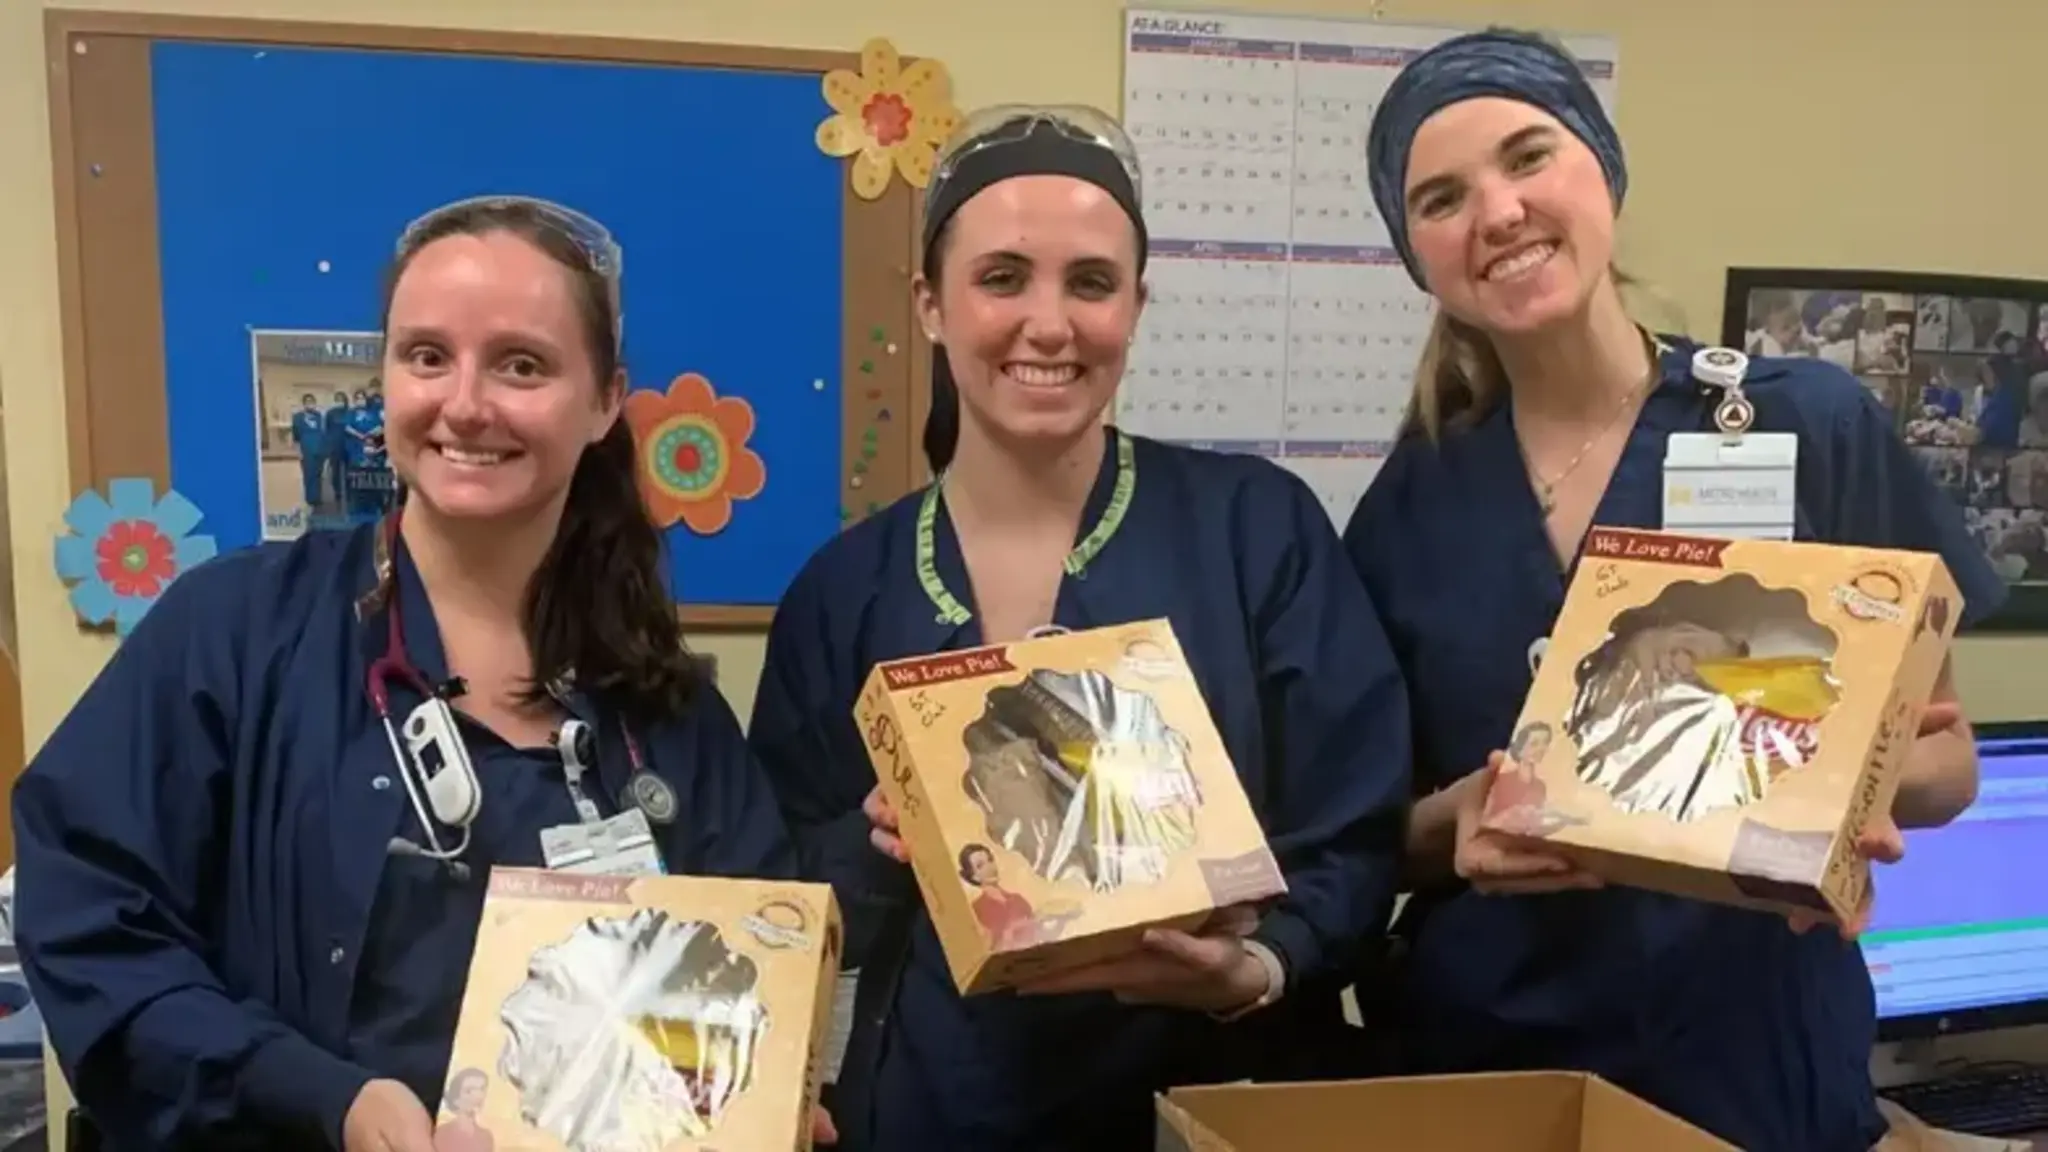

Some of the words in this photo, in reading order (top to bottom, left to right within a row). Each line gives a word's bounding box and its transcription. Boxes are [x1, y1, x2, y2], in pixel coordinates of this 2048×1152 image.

[1594, 534, 1621, 554] We
[1623, 537, 1671, 558] Love
[1673, 541, 1715, 562] Pie!
[887, 667, 920, 685] We
[919, 663, 966, 681] Love
[965, 652, 1003, 674] Pie!
[581, 879, 620, 899] Pie!
